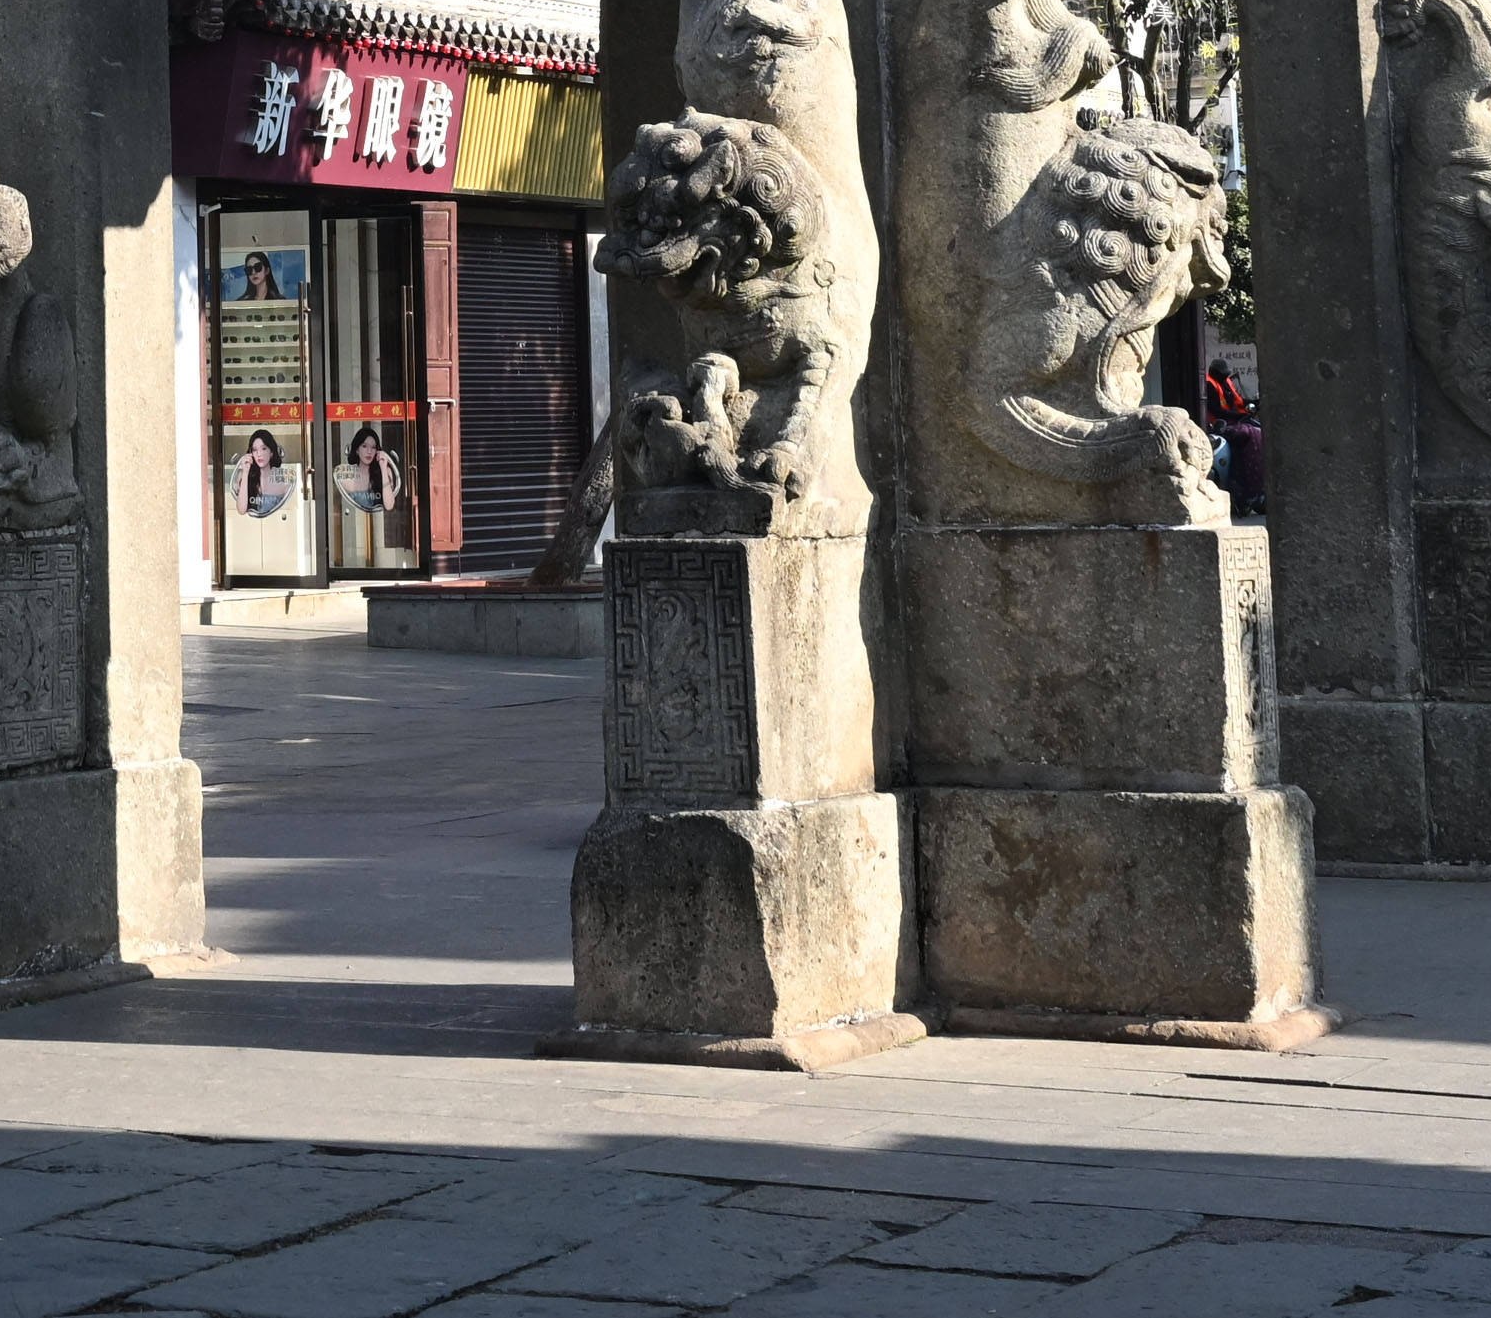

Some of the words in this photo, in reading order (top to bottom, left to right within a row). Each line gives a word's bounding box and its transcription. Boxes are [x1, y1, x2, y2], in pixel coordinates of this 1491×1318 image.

[249, 61, 456, 171] 新华眼镜
[233, 405, 301, 419] 新华眼镜
[335, 404, 403, 418] 新华眼镜
